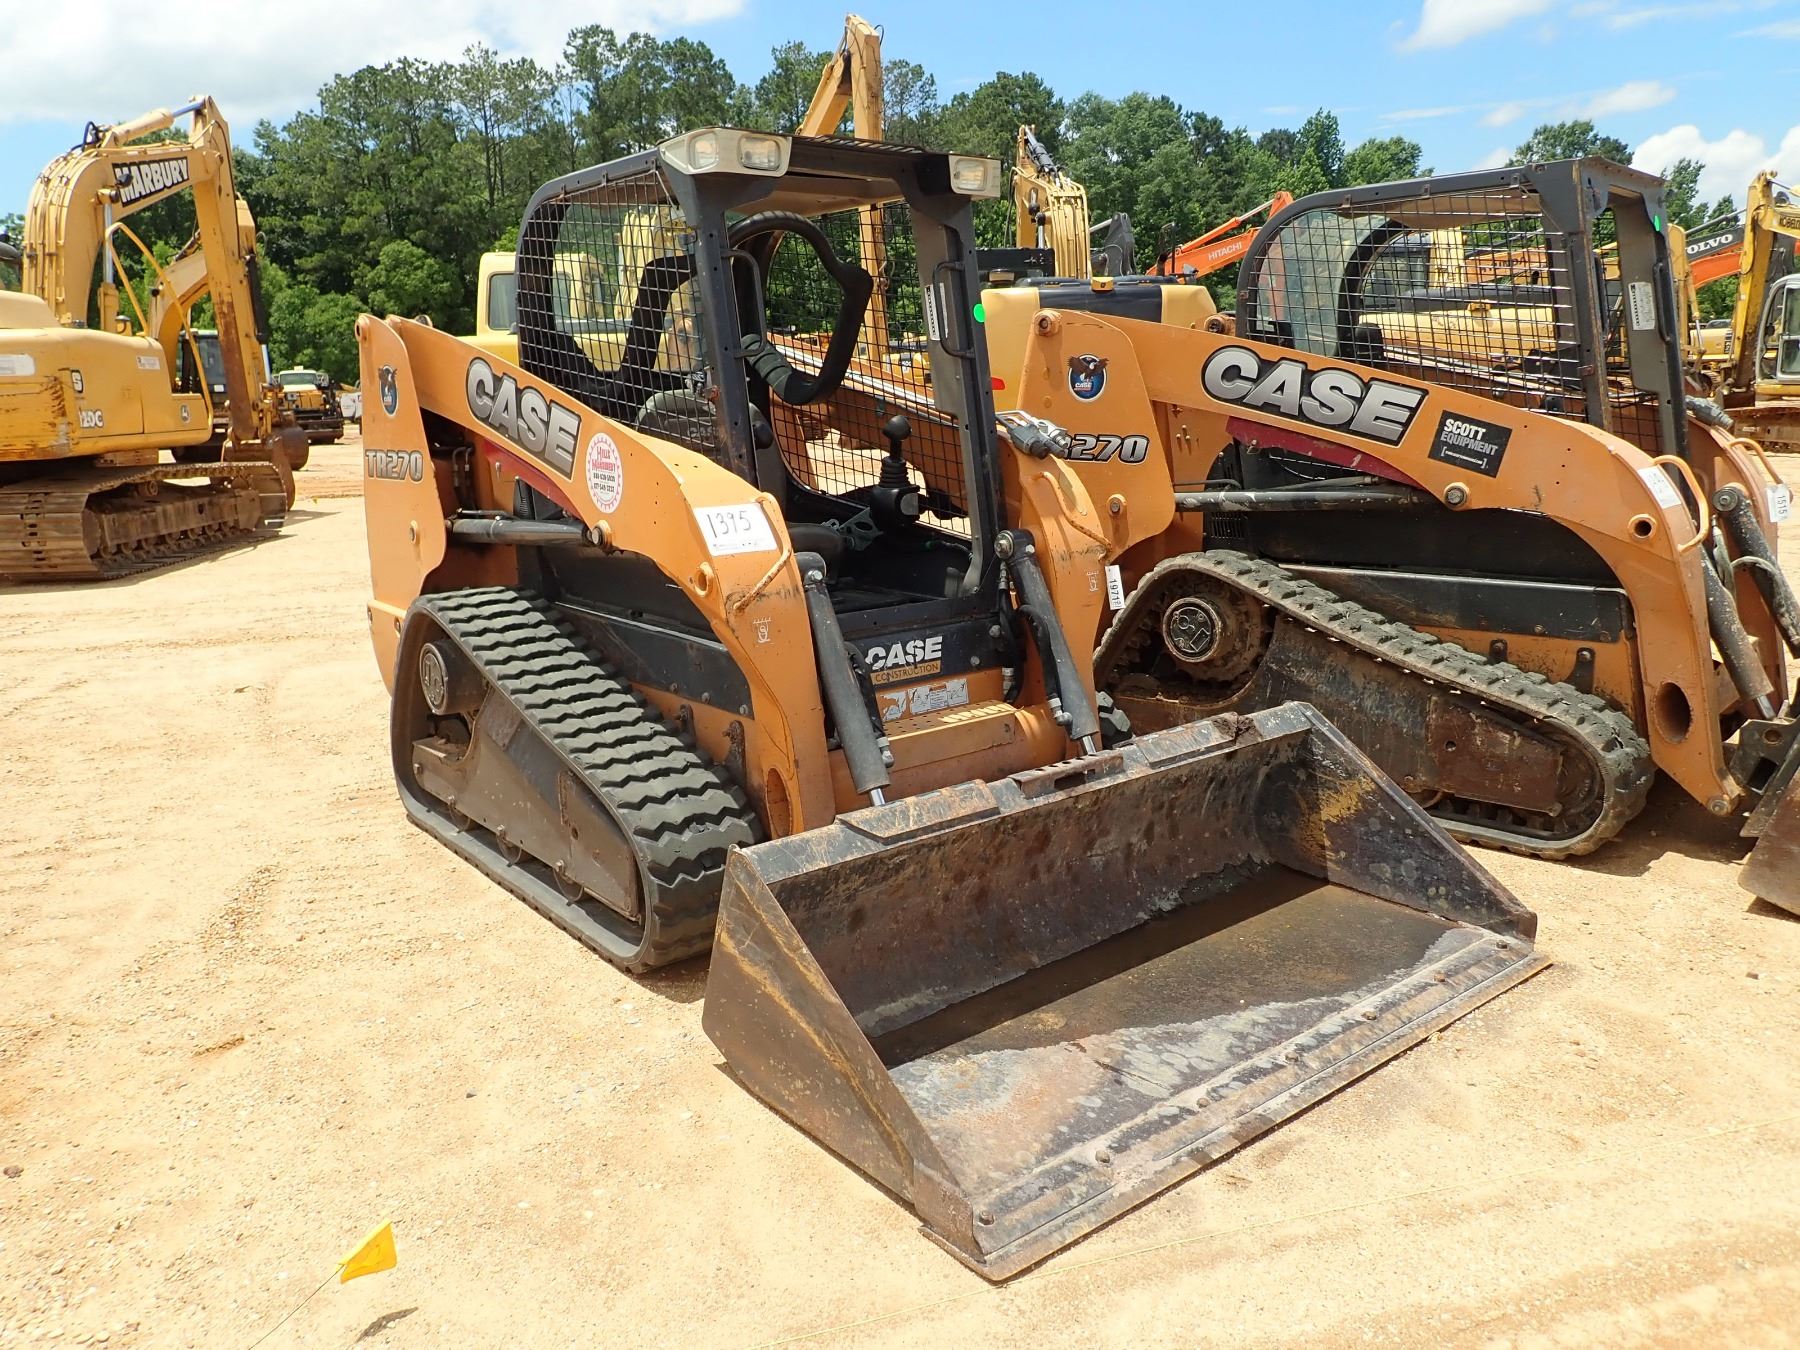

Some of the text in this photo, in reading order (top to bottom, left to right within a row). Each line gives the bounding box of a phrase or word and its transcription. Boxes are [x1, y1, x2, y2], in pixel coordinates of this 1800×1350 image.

[114, 159, 188, 203] MARBURY
[1208, 240, 1243, 262] HITACHI
[1685, 234, 1733, 254] OLVO
[1203, 346, 1428, 444] CASE
[466, 357, 581, 480] CASE
[1443, 418, 1486, 441] SCOTT
[1064, 434, 1150, 462] 270
[1440, 430, 1499, 456] EQUIPMENT
[364, 449, 423, 482] TR270
[707, 510, 751, 538] 1395
[864, 635, 943, 671] CASE
[875, 663, 939, 683] CONSTRUCTION
